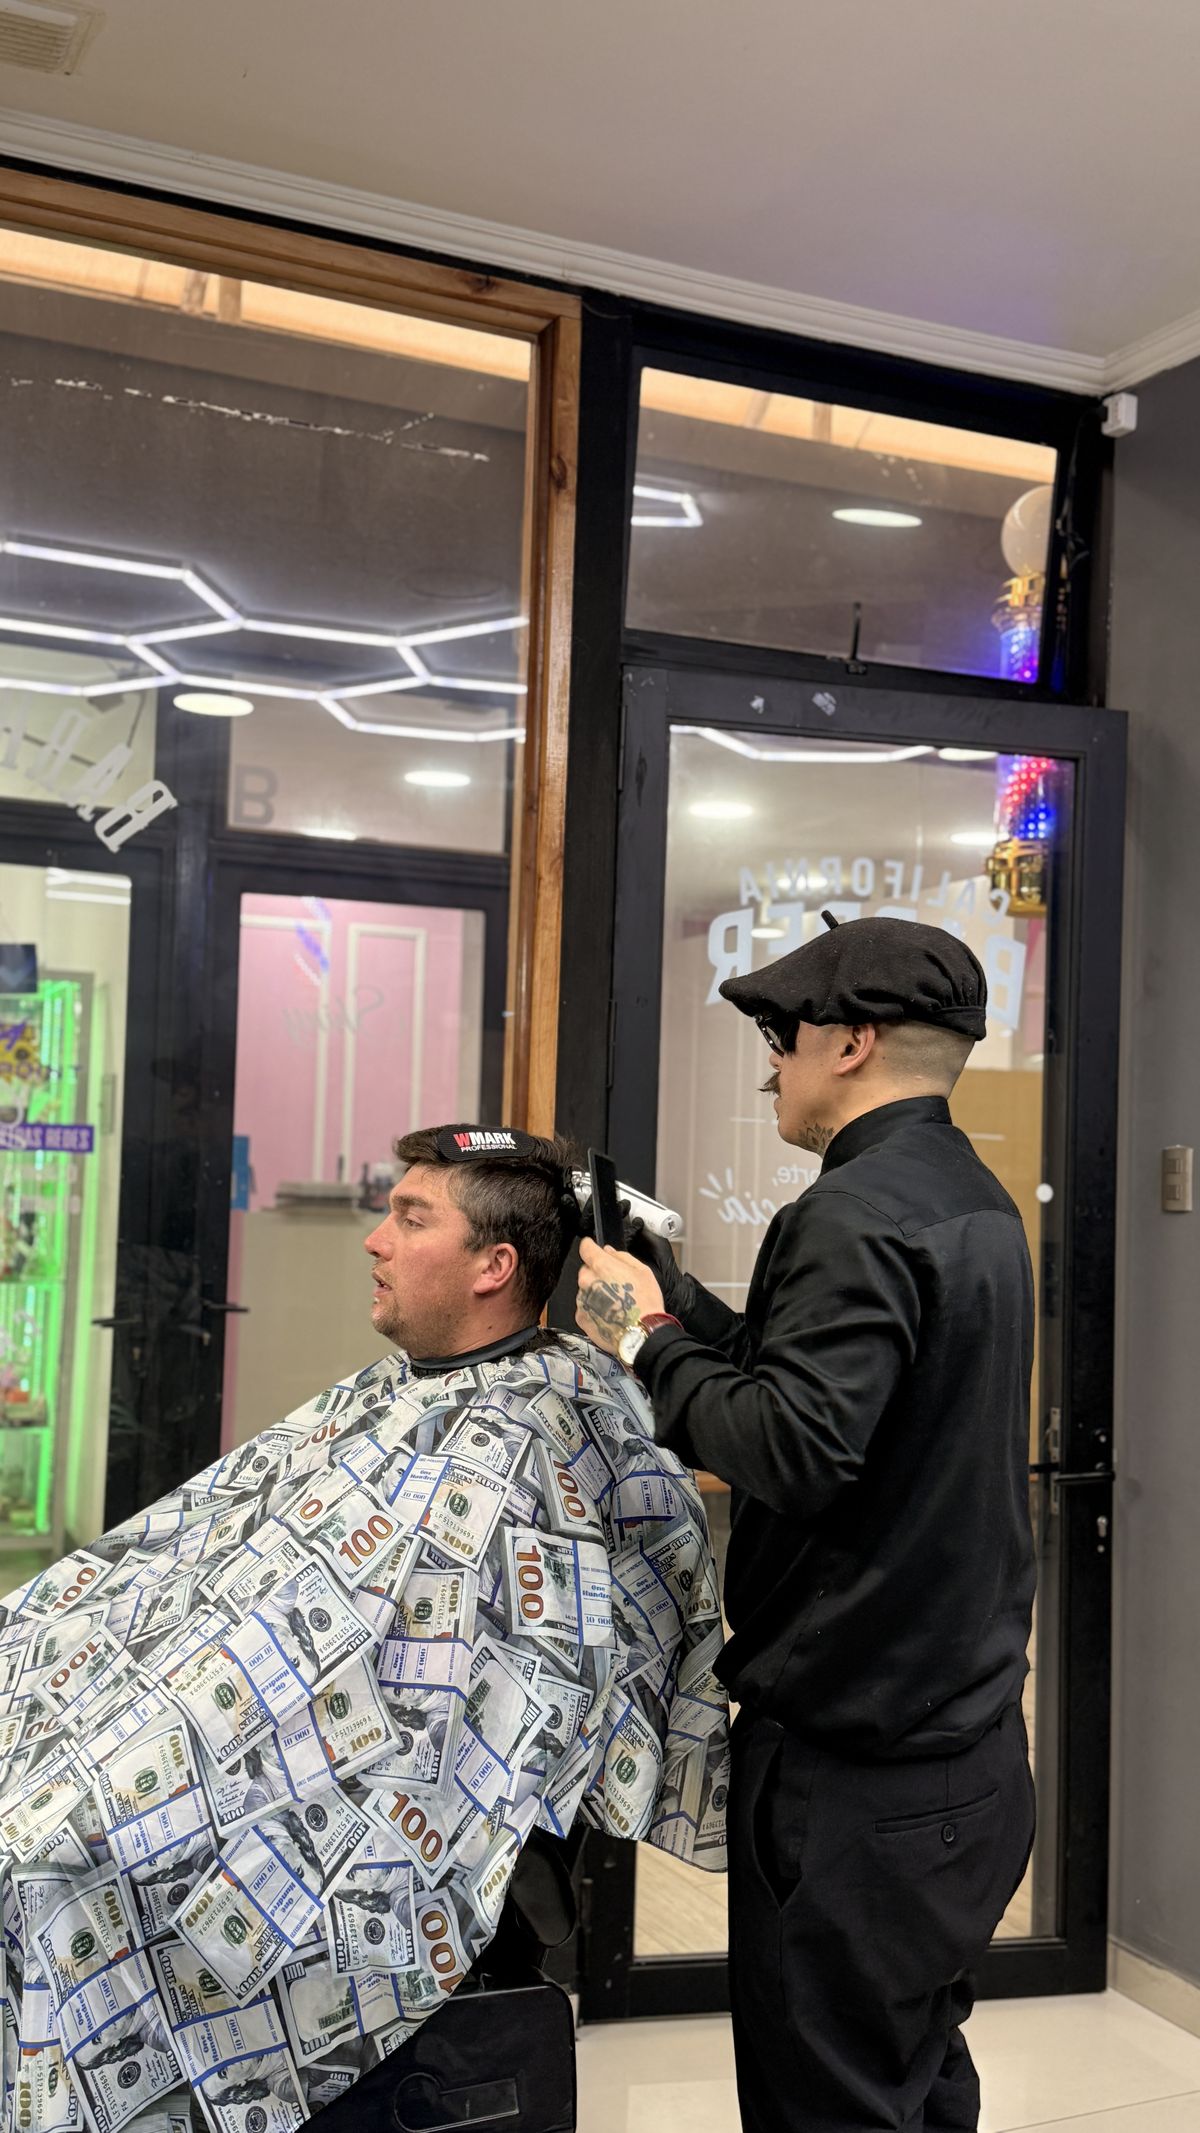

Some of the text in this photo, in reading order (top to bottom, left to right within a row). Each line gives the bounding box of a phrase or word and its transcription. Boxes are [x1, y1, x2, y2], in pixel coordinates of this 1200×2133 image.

[453, 1131, 516, 1148] WMARK
[461, 1143, 517, 1153] PROFESSIONAL
[475, 1474, 500, 1492] 100
[339, 1515, 394, 1567] 100
[441, 1531, 474, 1556] 100
[670, 1534, 692, 1550] 100
[51, 1567, 97, 1612] 100
[449, 1580, 460, 1613] 100
[516, 1545, 544, 1619] 100
[347, 1630, 370, 1652] 100
[50, 1641, 101, 1688] 100
[170, 1734, 186, 1768] 100
[350, 1727, 382, 1753] 100
[221, 1806, 245, 1823] 100
[388, 1791, 442, 1862] 100
[347, 1823, 368, 1850] 100
[253, 1861, 276, 1890] 10 000
[483, 1864, 507, 1898] 100
[104, 1891, 124, 1929] 100
[185, 1891, 215, 1928] 100
[270, 1882, 295, 1917] Hundred
[282, 1898, 294, 1913] One
[336, 1938, 347, 1974] 100
[421, 1910, 465, 1994] 100
[101, 1979, 117, 2011] 10 000
[239, 1966, 263, 1994] 100
[76, 2008, 84, 2025] One
[77, 1991, 94, 2032] Hundred
[203, 2022, 219, 2062] Hundred
[229, 2018, 243, 2051] 10 000
[20, 2081, 31, 2127] 100
